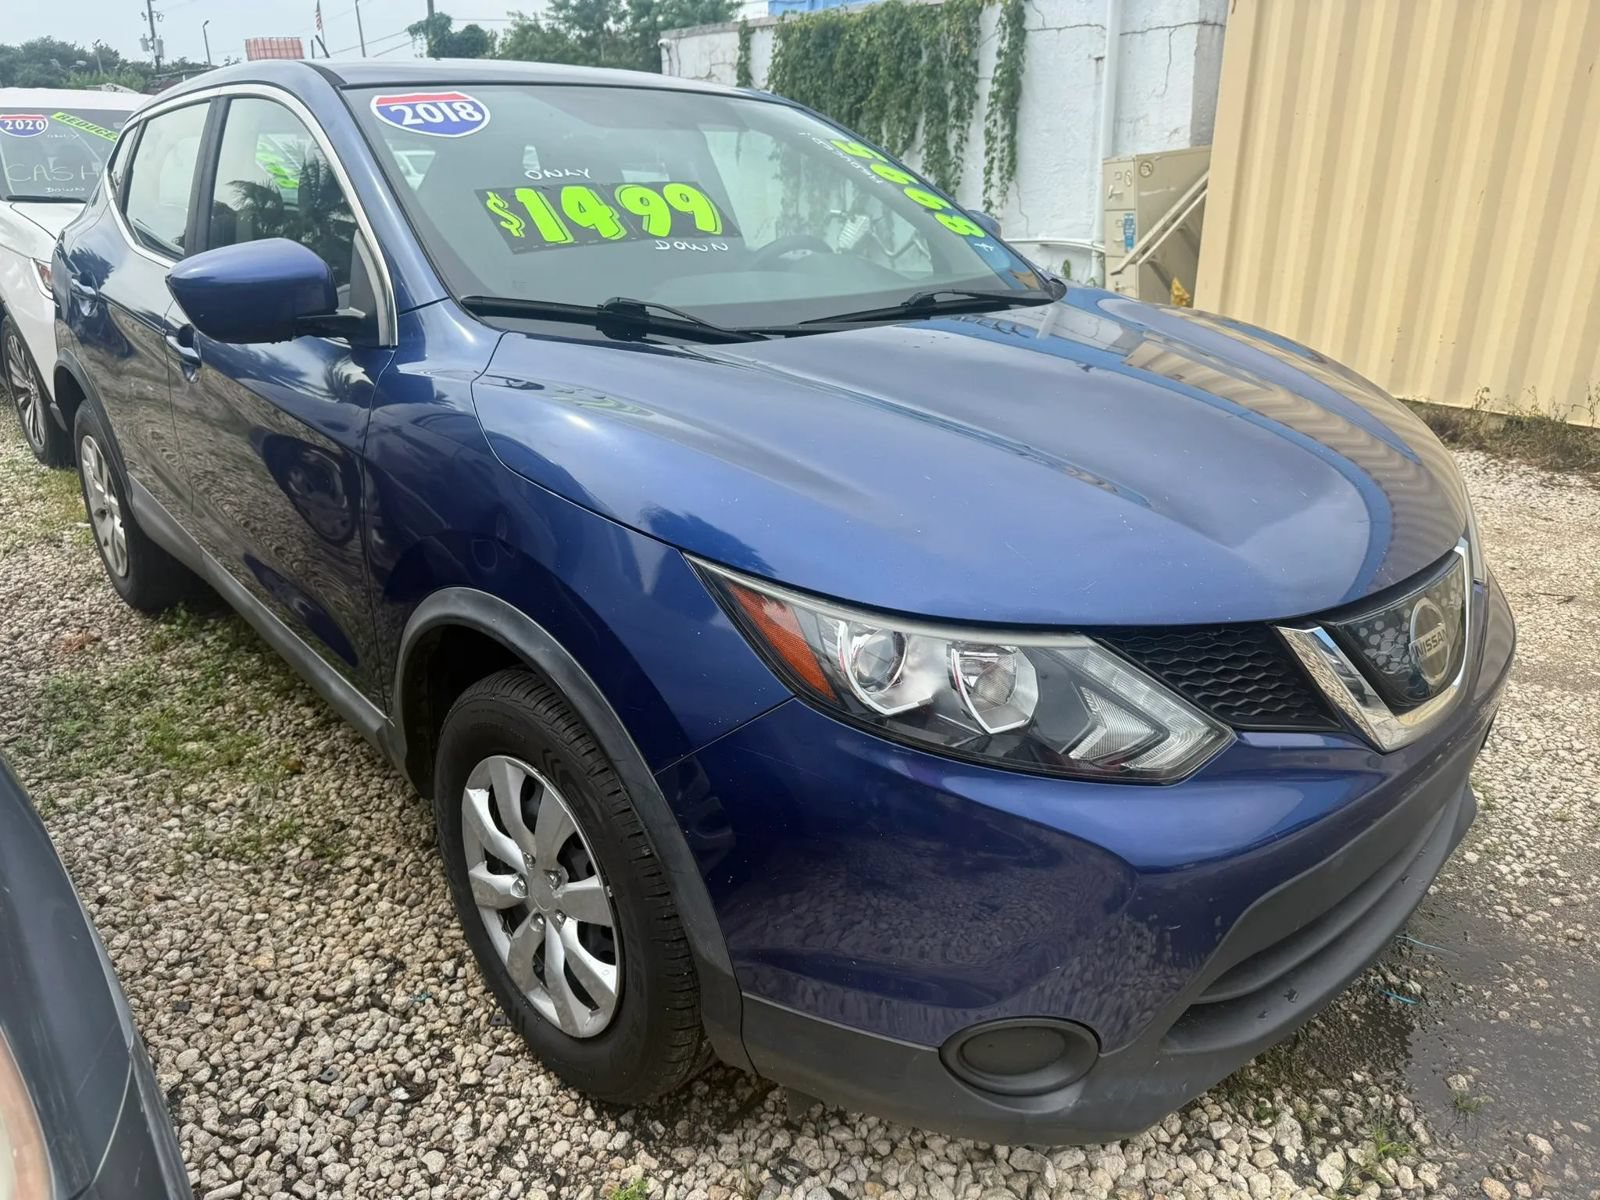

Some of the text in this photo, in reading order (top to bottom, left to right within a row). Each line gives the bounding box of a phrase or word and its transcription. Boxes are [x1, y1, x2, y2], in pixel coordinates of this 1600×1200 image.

[389, 102, 483, 125] 2018
[4, 120, 45, 131] 2020
[56, 113, 118, 140] REDUCE
[6, 163, 101, 181] CASH
[524, 167, 592, 180] ONLY
[485, 182, 722, 244] $1499
[655, 239, 729, 252] DOWN
[1414, 627, 1448, 658] NISSAN
